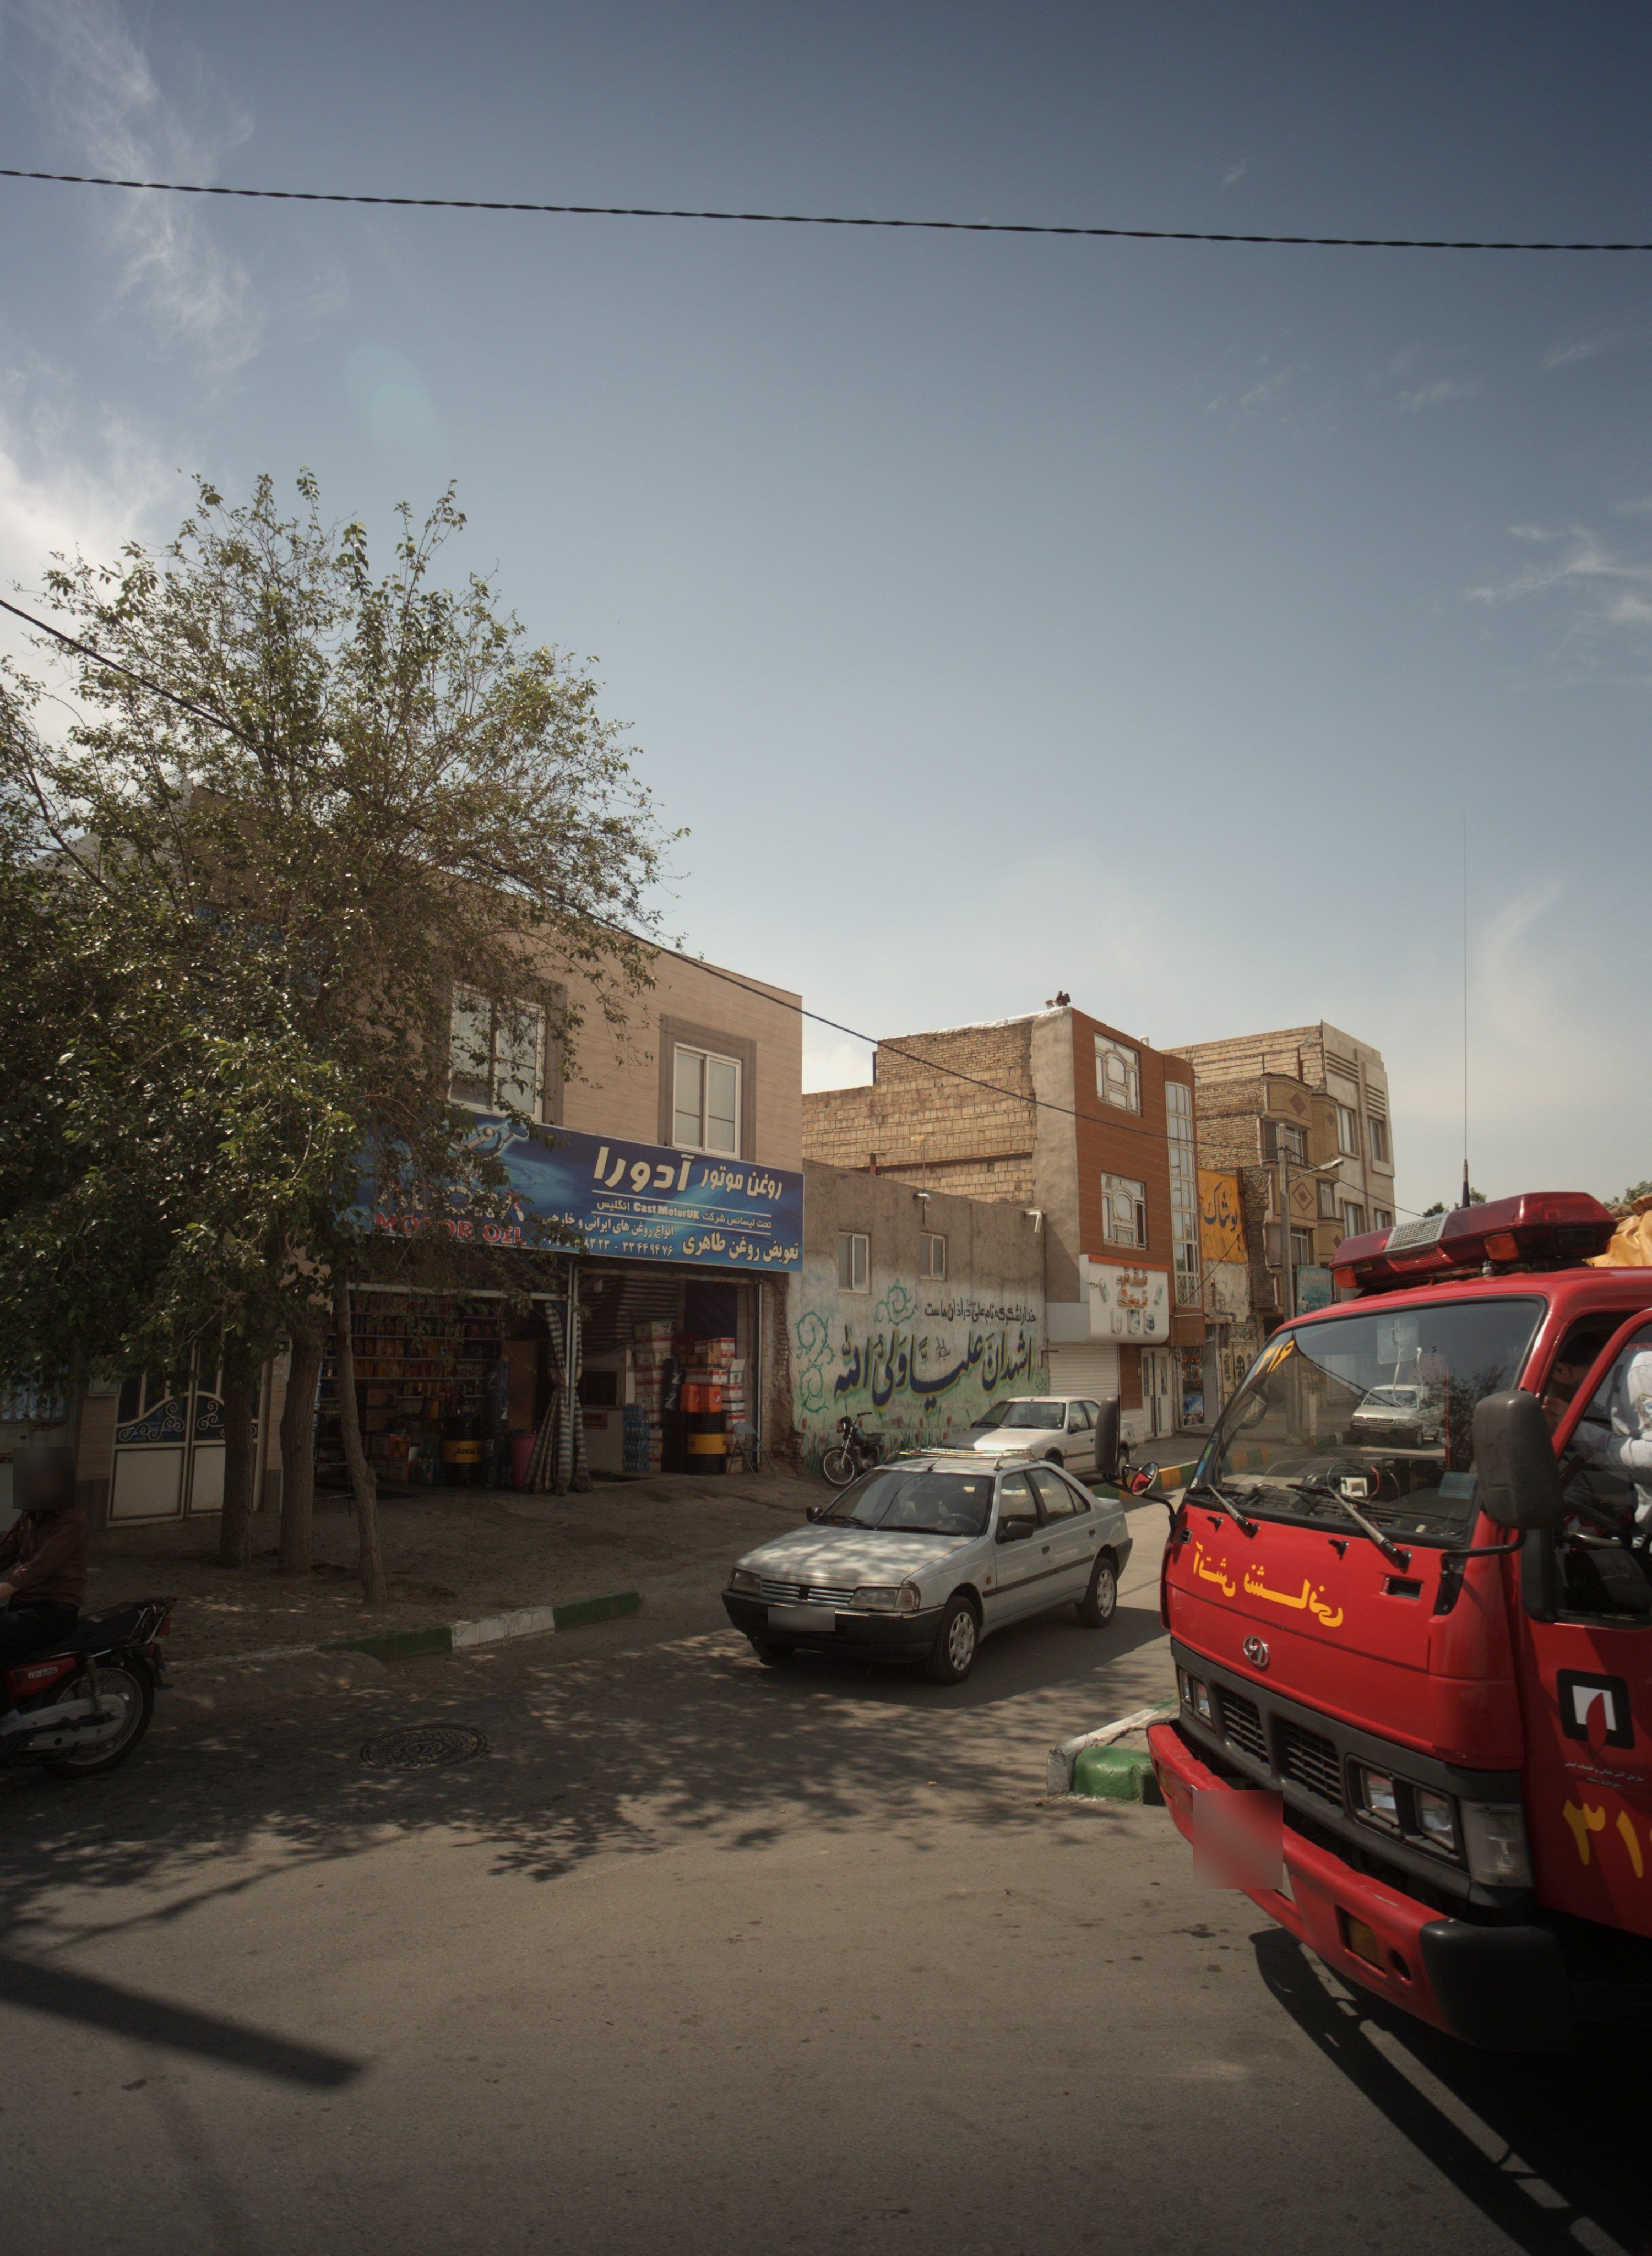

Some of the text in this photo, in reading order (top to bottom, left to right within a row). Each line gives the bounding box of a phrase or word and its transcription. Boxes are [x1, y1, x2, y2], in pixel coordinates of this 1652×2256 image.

[593, 1146, 782, 1200] روغن موتور آدورا
[596, 1198, 630, 1211] انگلیس
[375, 1212, 474, 1242] MOOR
[482, 1224, 527, 1246] OIL
[578, 1219, 583, 1229] و
[585, 1216, 611, 1233] ایرانی
[612, 1219, 630, 1234] های
[702, 1212, 771, 1229] تحت لیسانس شرکت
[631, 1222, 653, 1238] روغن
[654, 1224, 675, 1239] انواع
[683, 1232, 800, 1265] تعویض روغن طاهری
[1562, 1799, 1652, 1879] ۳۱
